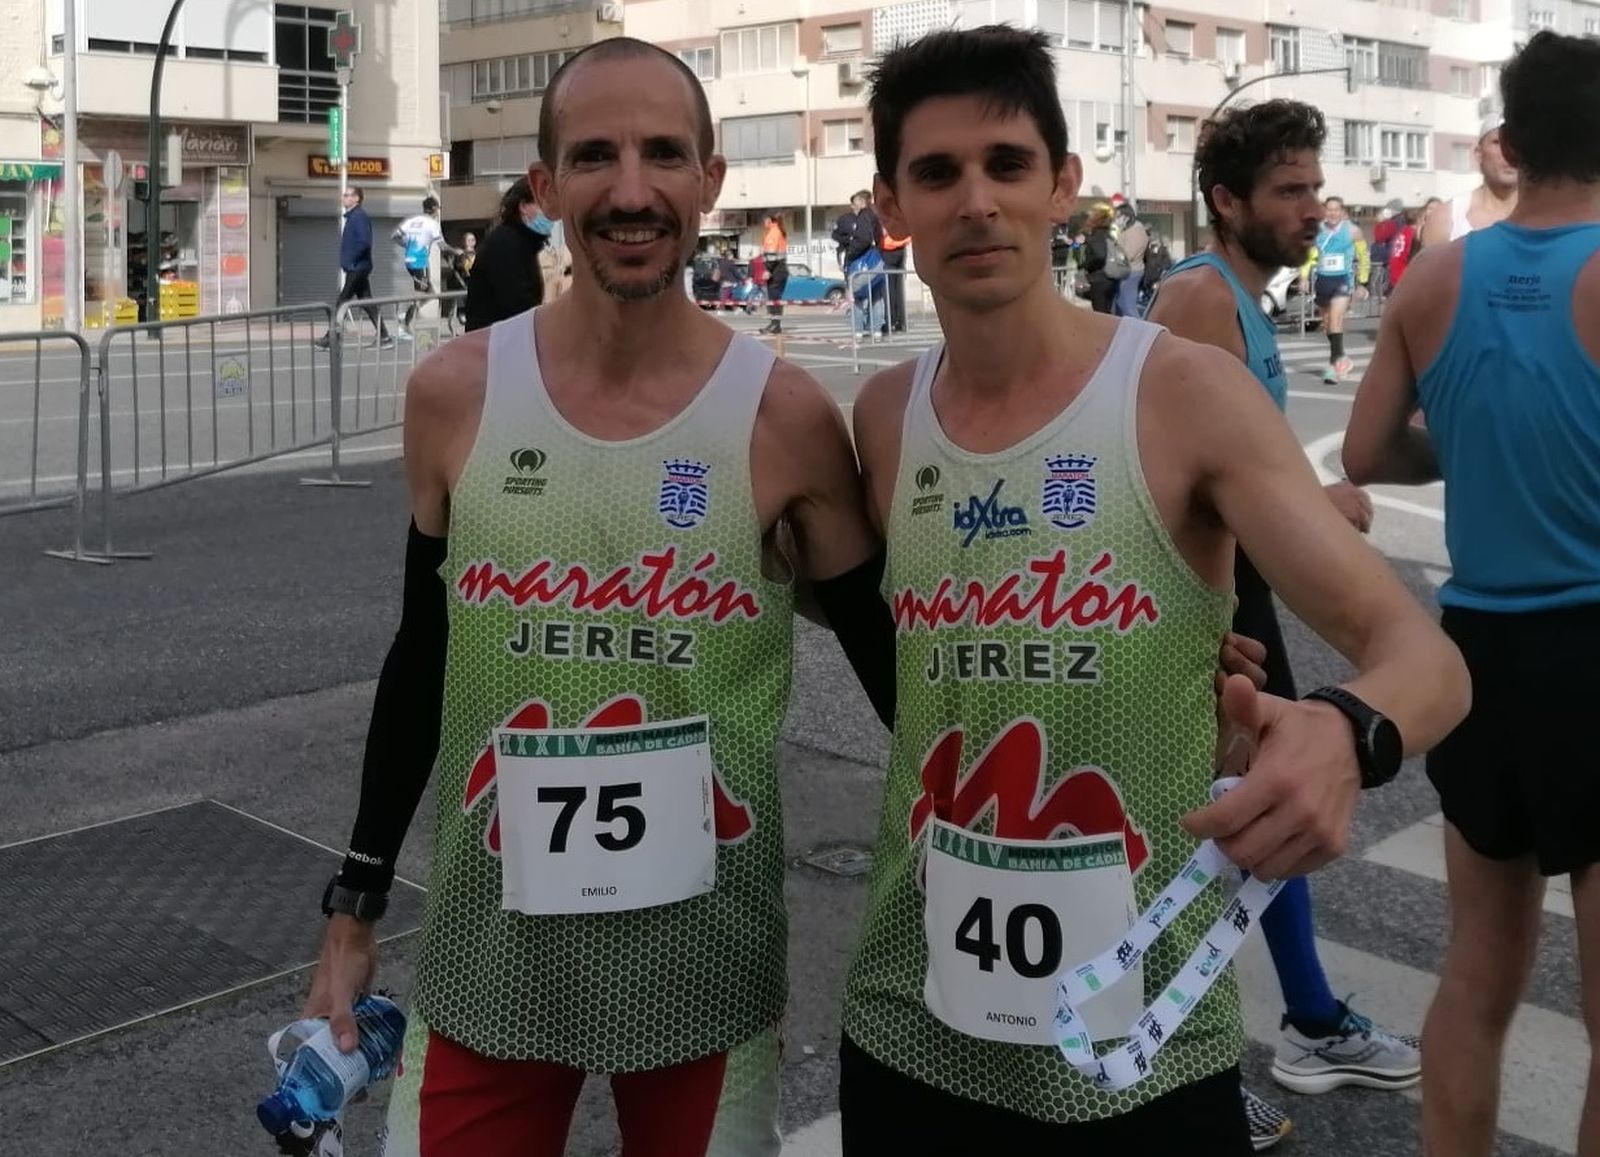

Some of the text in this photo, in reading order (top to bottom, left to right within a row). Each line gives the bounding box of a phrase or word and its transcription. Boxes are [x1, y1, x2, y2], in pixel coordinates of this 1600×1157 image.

[458, 546, 760, 622] maratón
[509, 622, 694, 665] JEREZ
[927, 642, 1097, 682] JEREZ
[644, 739, 664, 750] DE
[537, 782, 646, 853] 75
[1063, 858, 1083, 869] DE
[581, 886, 618, 897] EMILIO
[955, 897, 1063, 978] 40
[985, 1010, 1037, 1027] ANTONIO
